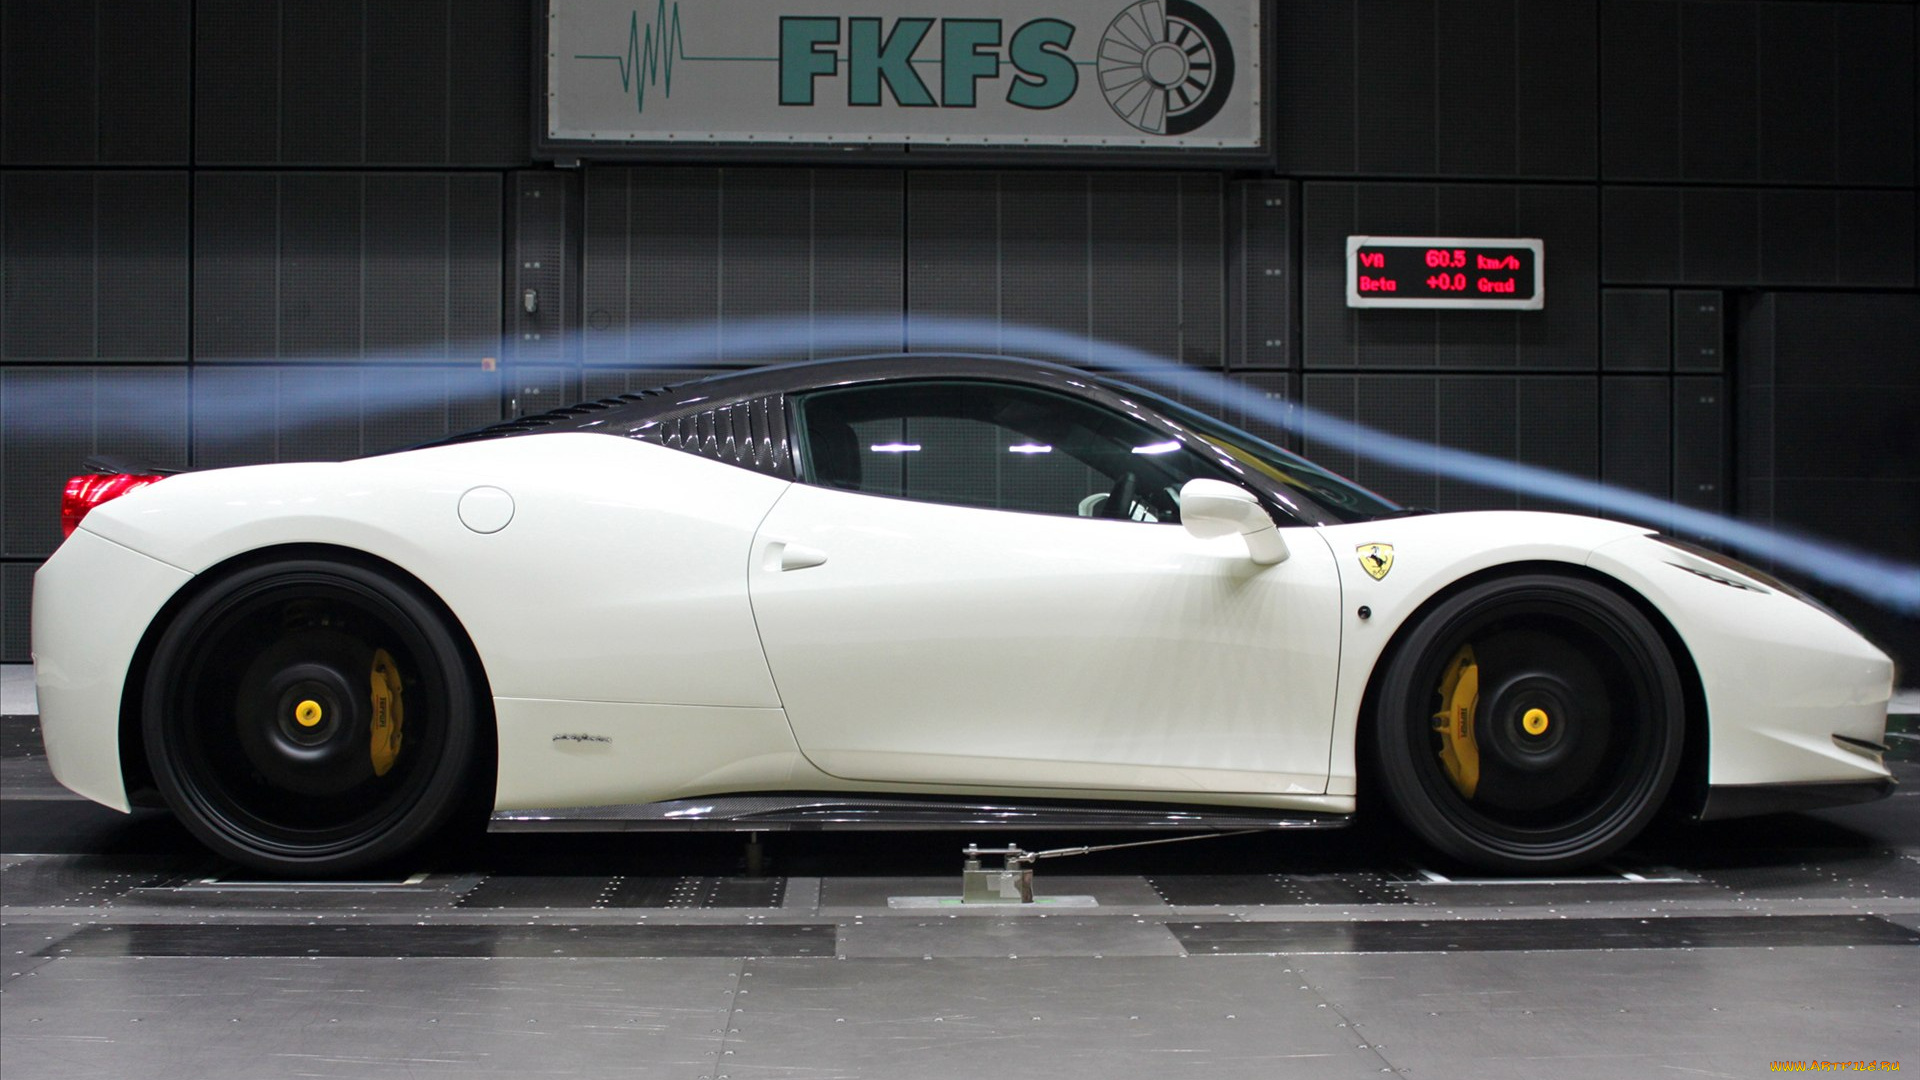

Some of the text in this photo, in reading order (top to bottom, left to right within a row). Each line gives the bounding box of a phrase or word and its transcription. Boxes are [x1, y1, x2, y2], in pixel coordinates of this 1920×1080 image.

[778, 15, 1079, 110] FKFS
[1425, 249, 1467, 268] 60.5
[1477, 254, 1521, 270] km/h
[1359, 273, 1516, 293] Beta +0.0 Grad
